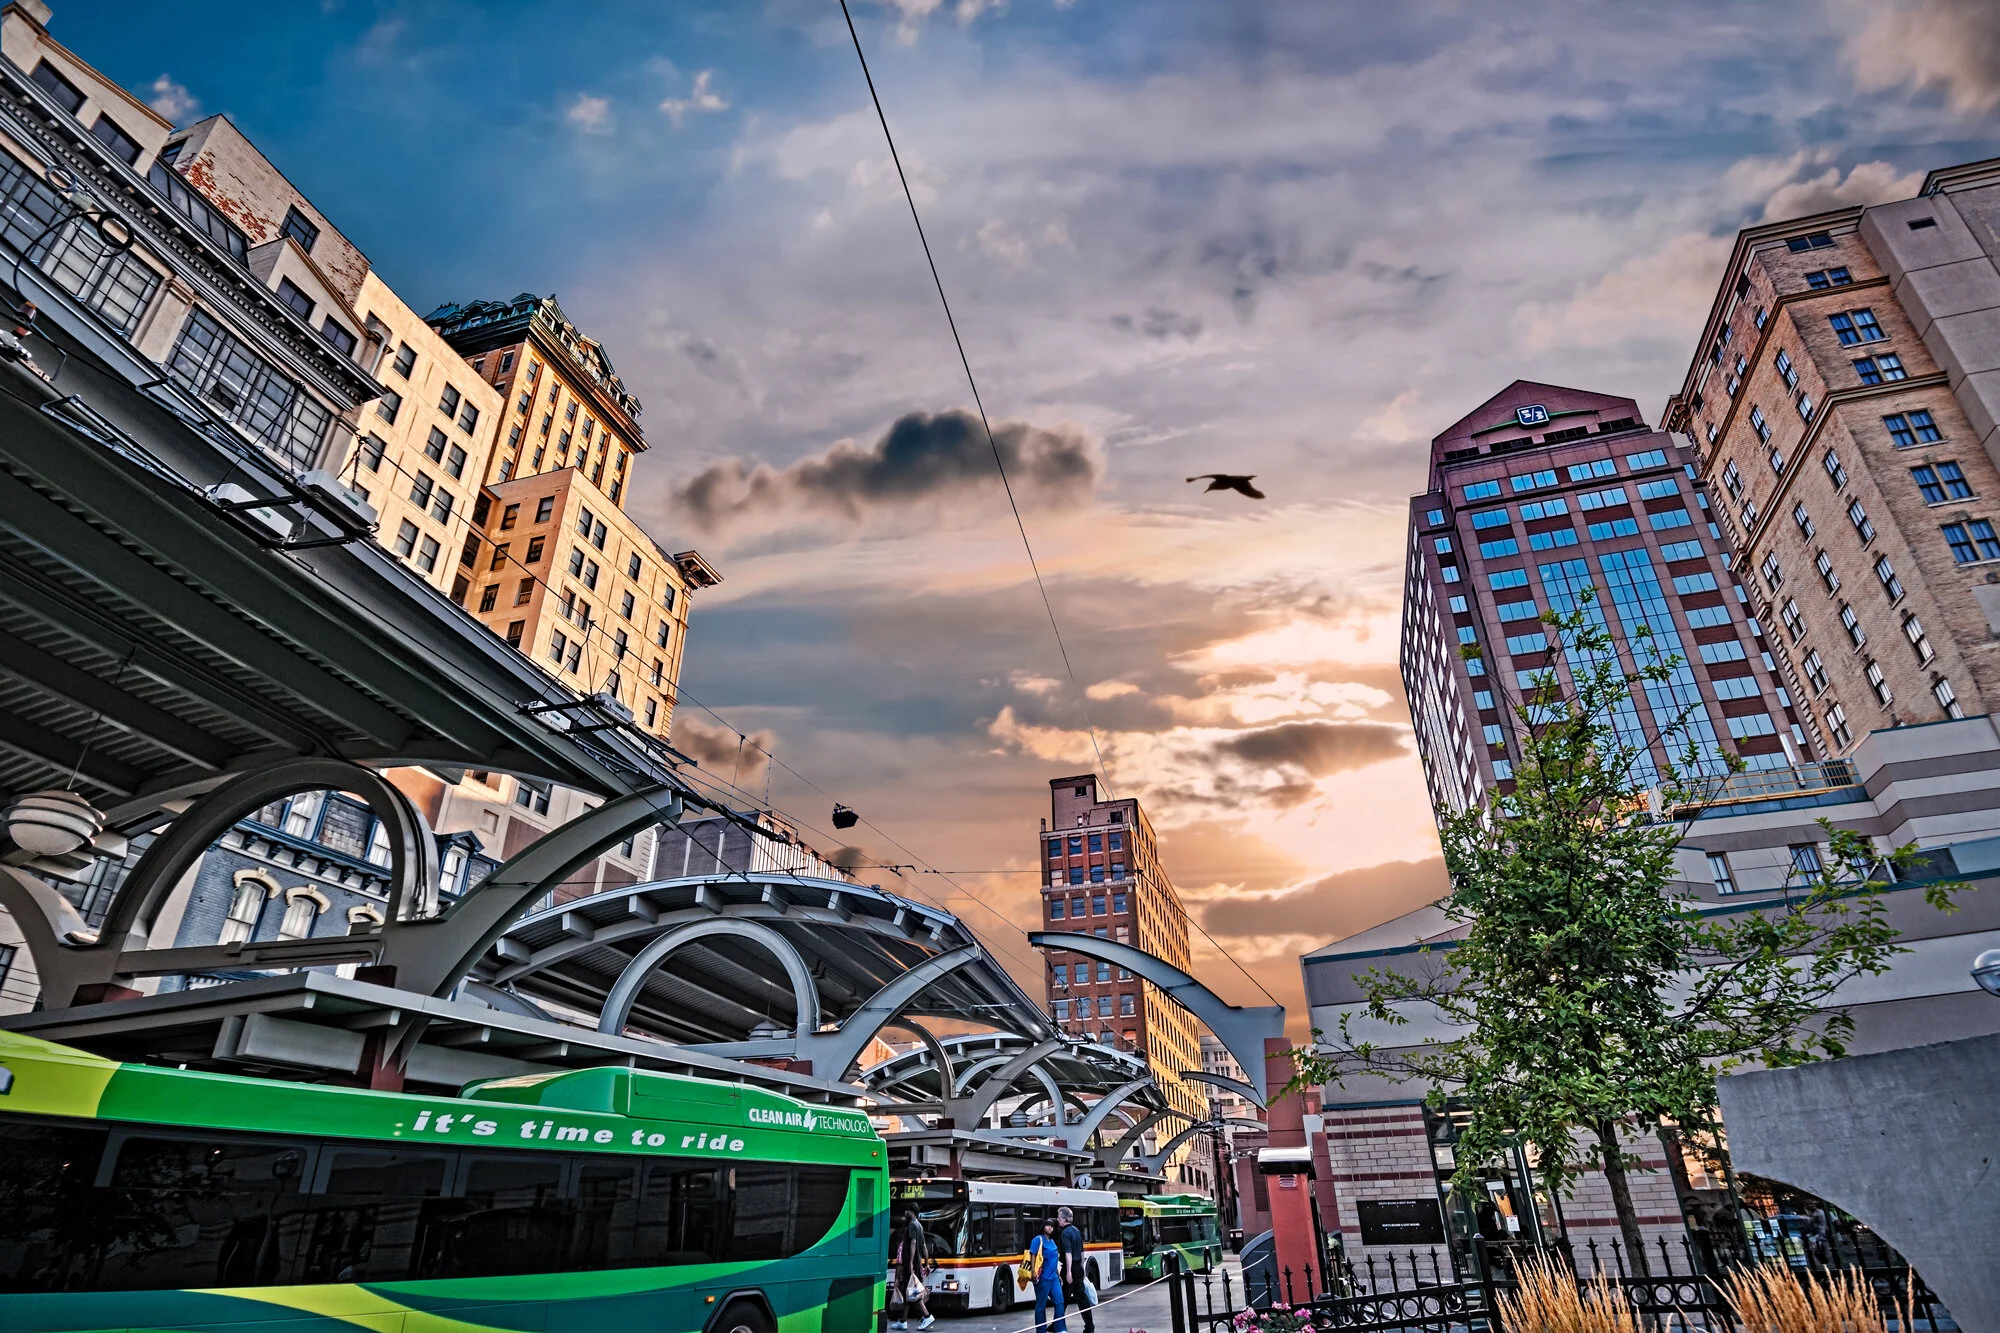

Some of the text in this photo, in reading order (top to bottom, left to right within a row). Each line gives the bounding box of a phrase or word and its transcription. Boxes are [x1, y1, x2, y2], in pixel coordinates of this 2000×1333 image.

[1520, 408, 1544, 421] 5/3
[413, 1110, 745, 1151] it's time to ride
[749, 1108, 870, 1133] CLEAN AIR TECHNOLOGY
